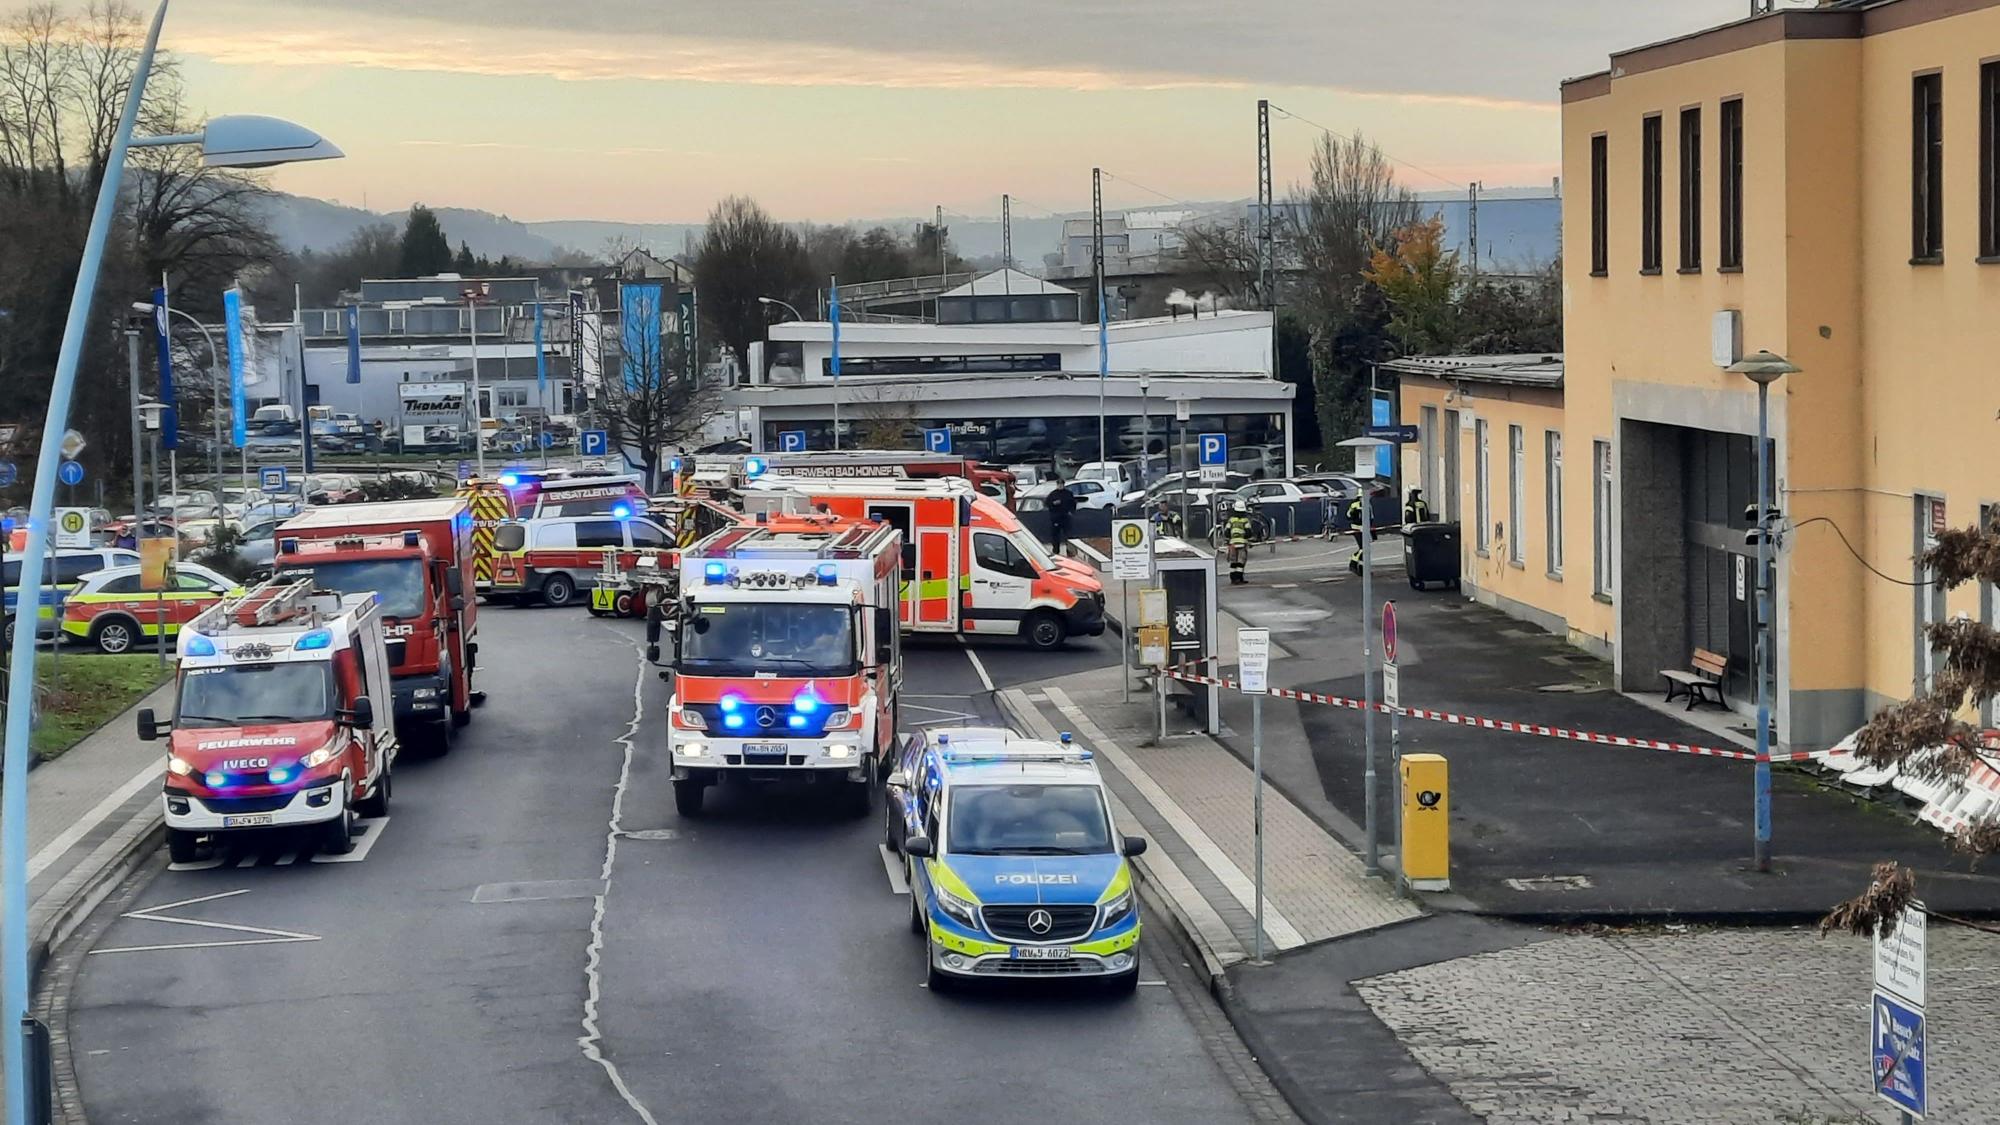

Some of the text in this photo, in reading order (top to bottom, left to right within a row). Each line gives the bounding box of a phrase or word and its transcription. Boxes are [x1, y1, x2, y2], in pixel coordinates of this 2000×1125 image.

[403, 400, 461, 411] THOMAS
[586, 435, 600, 453] P
[785, 435, 799, 451] P
[931, 432, 945, 450] P
[1205, 438, 1220, 462] P
[780, 466, 892, 477] FEUERWEHR BAD HONNEF
[550, 487, 626, 500] EINSATZLEITUNG
[68, 518, 78, 528] H
[1125, 529, 1136, 542] H
[198, 737, 296, 750] FEUERWEHR
[223, 758, 268, 769] IVECO
[994, 874, 1079, 884] POLIZEI
